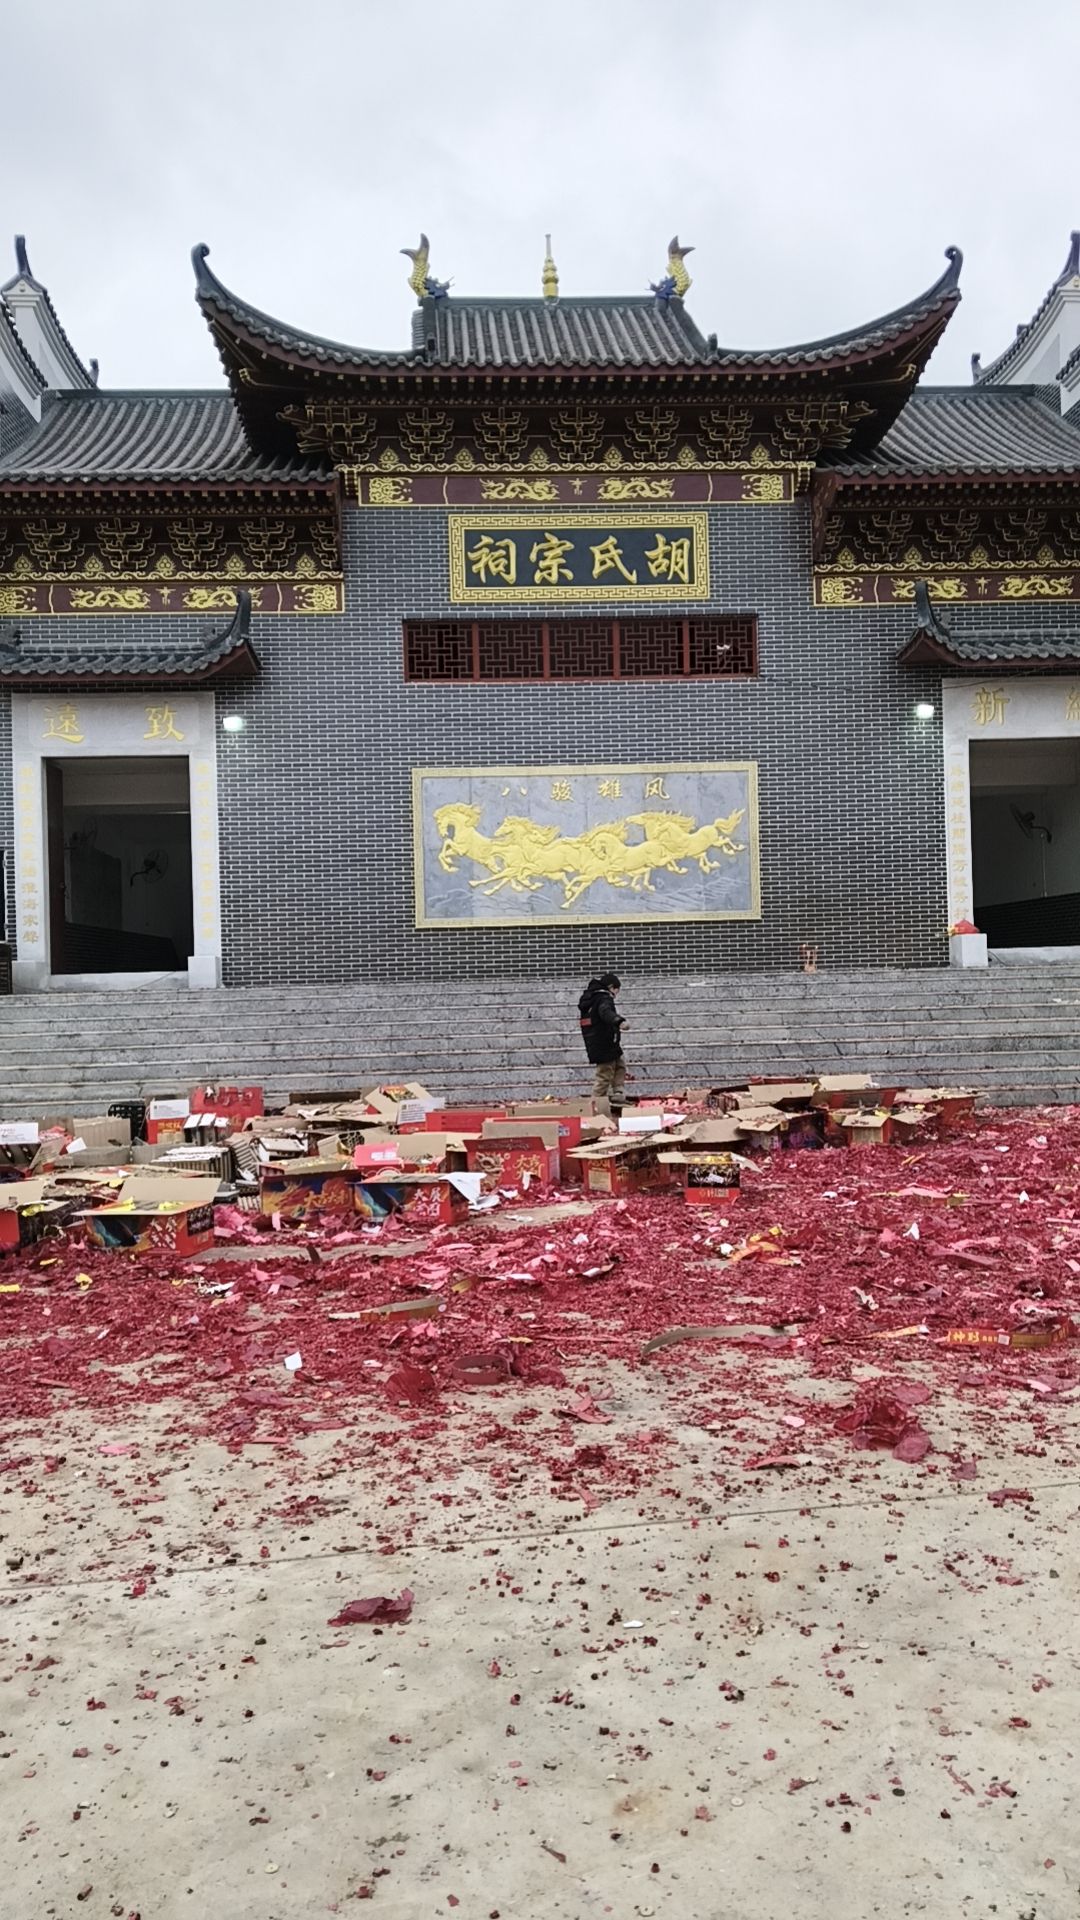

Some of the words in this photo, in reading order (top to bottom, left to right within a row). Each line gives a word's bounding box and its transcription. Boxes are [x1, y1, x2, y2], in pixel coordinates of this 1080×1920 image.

[467, 532, 691, 585] 胡氏宗祠
[41, 702, 186, 744] 致遠
[502, 777, 671, 801] 八骏雄风
